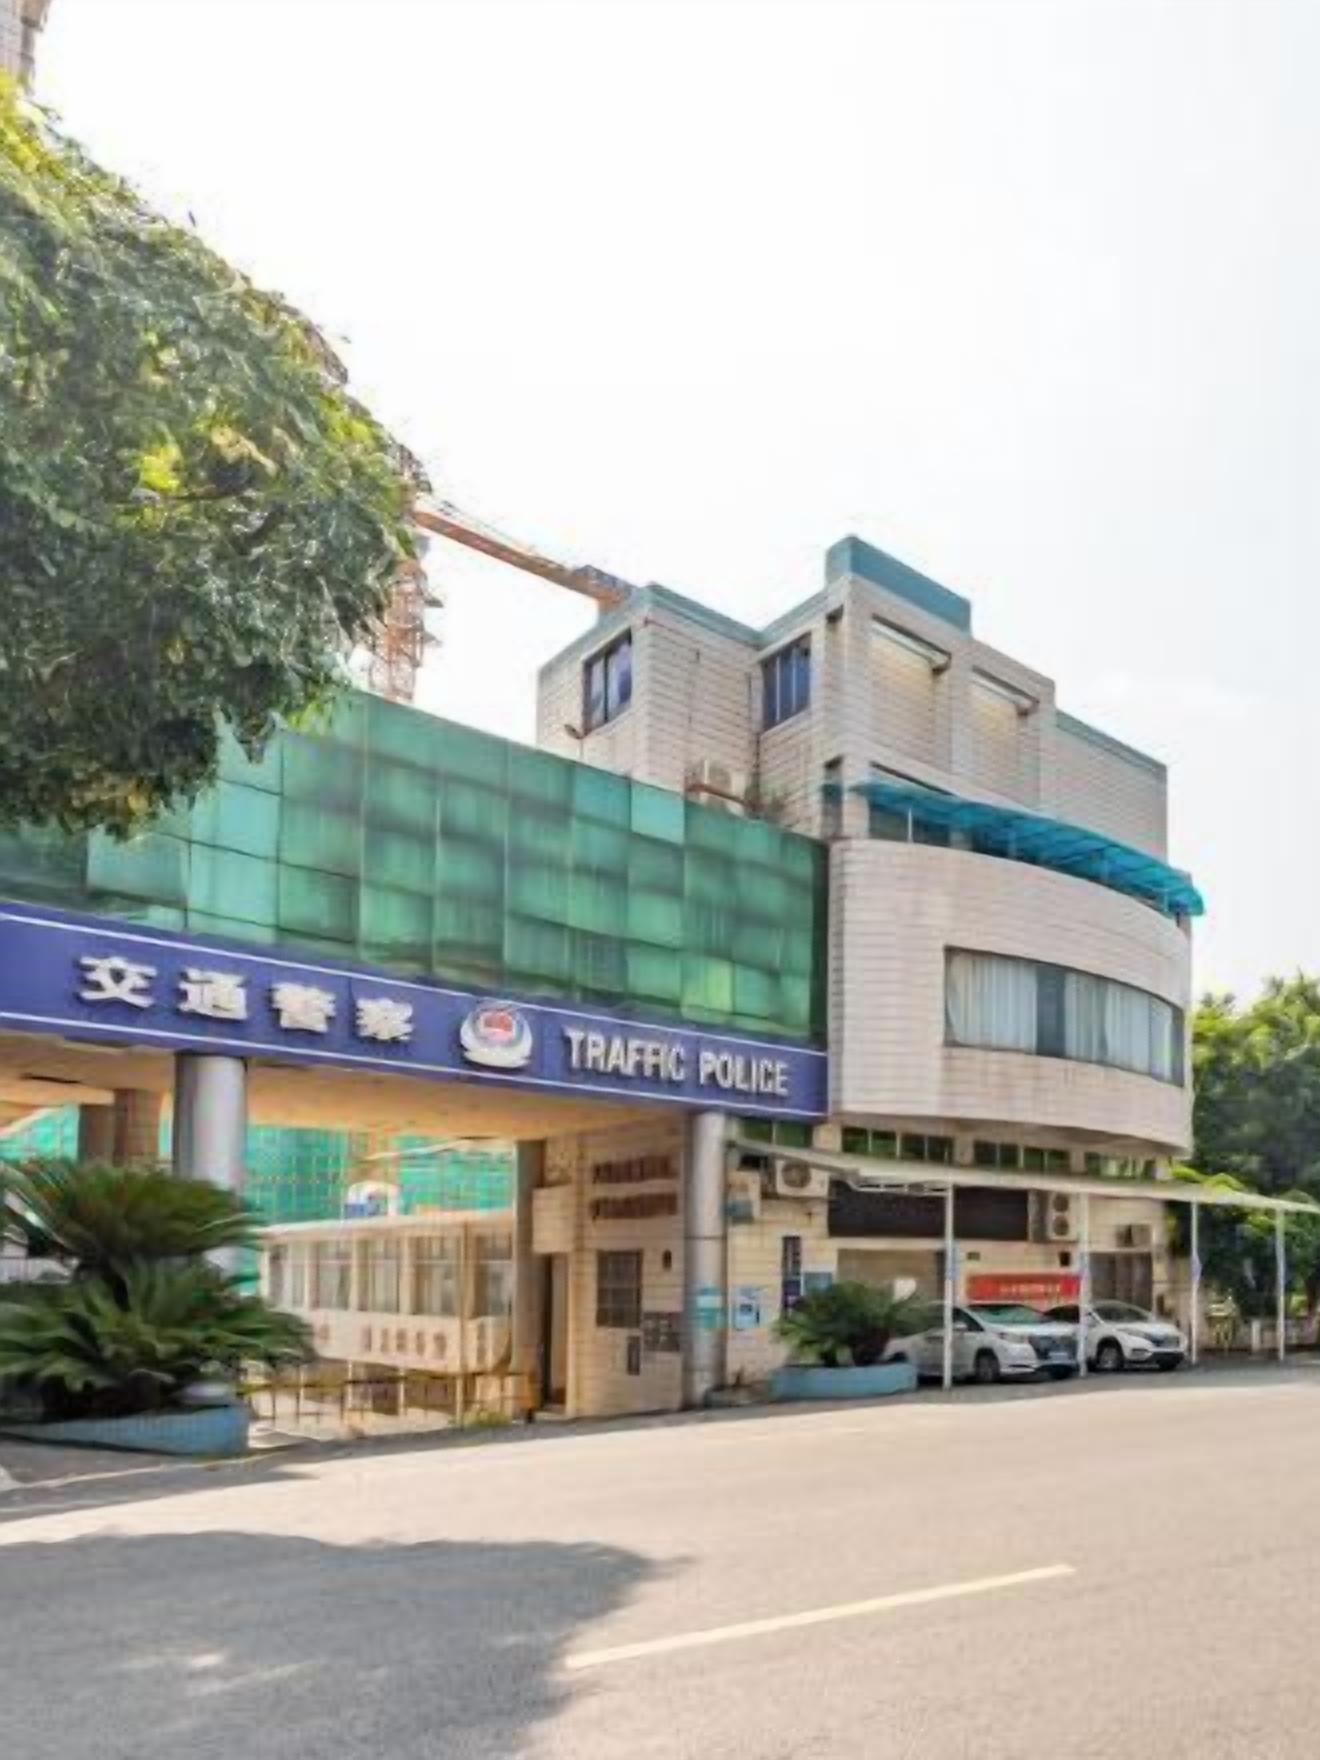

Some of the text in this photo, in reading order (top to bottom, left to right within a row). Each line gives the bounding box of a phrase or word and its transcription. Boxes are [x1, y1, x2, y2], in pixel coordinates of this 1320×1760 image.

[76, 955, 415, 1042] 交通警察
[563, 1025, 790, 1097] TRAFFIC POLICE
